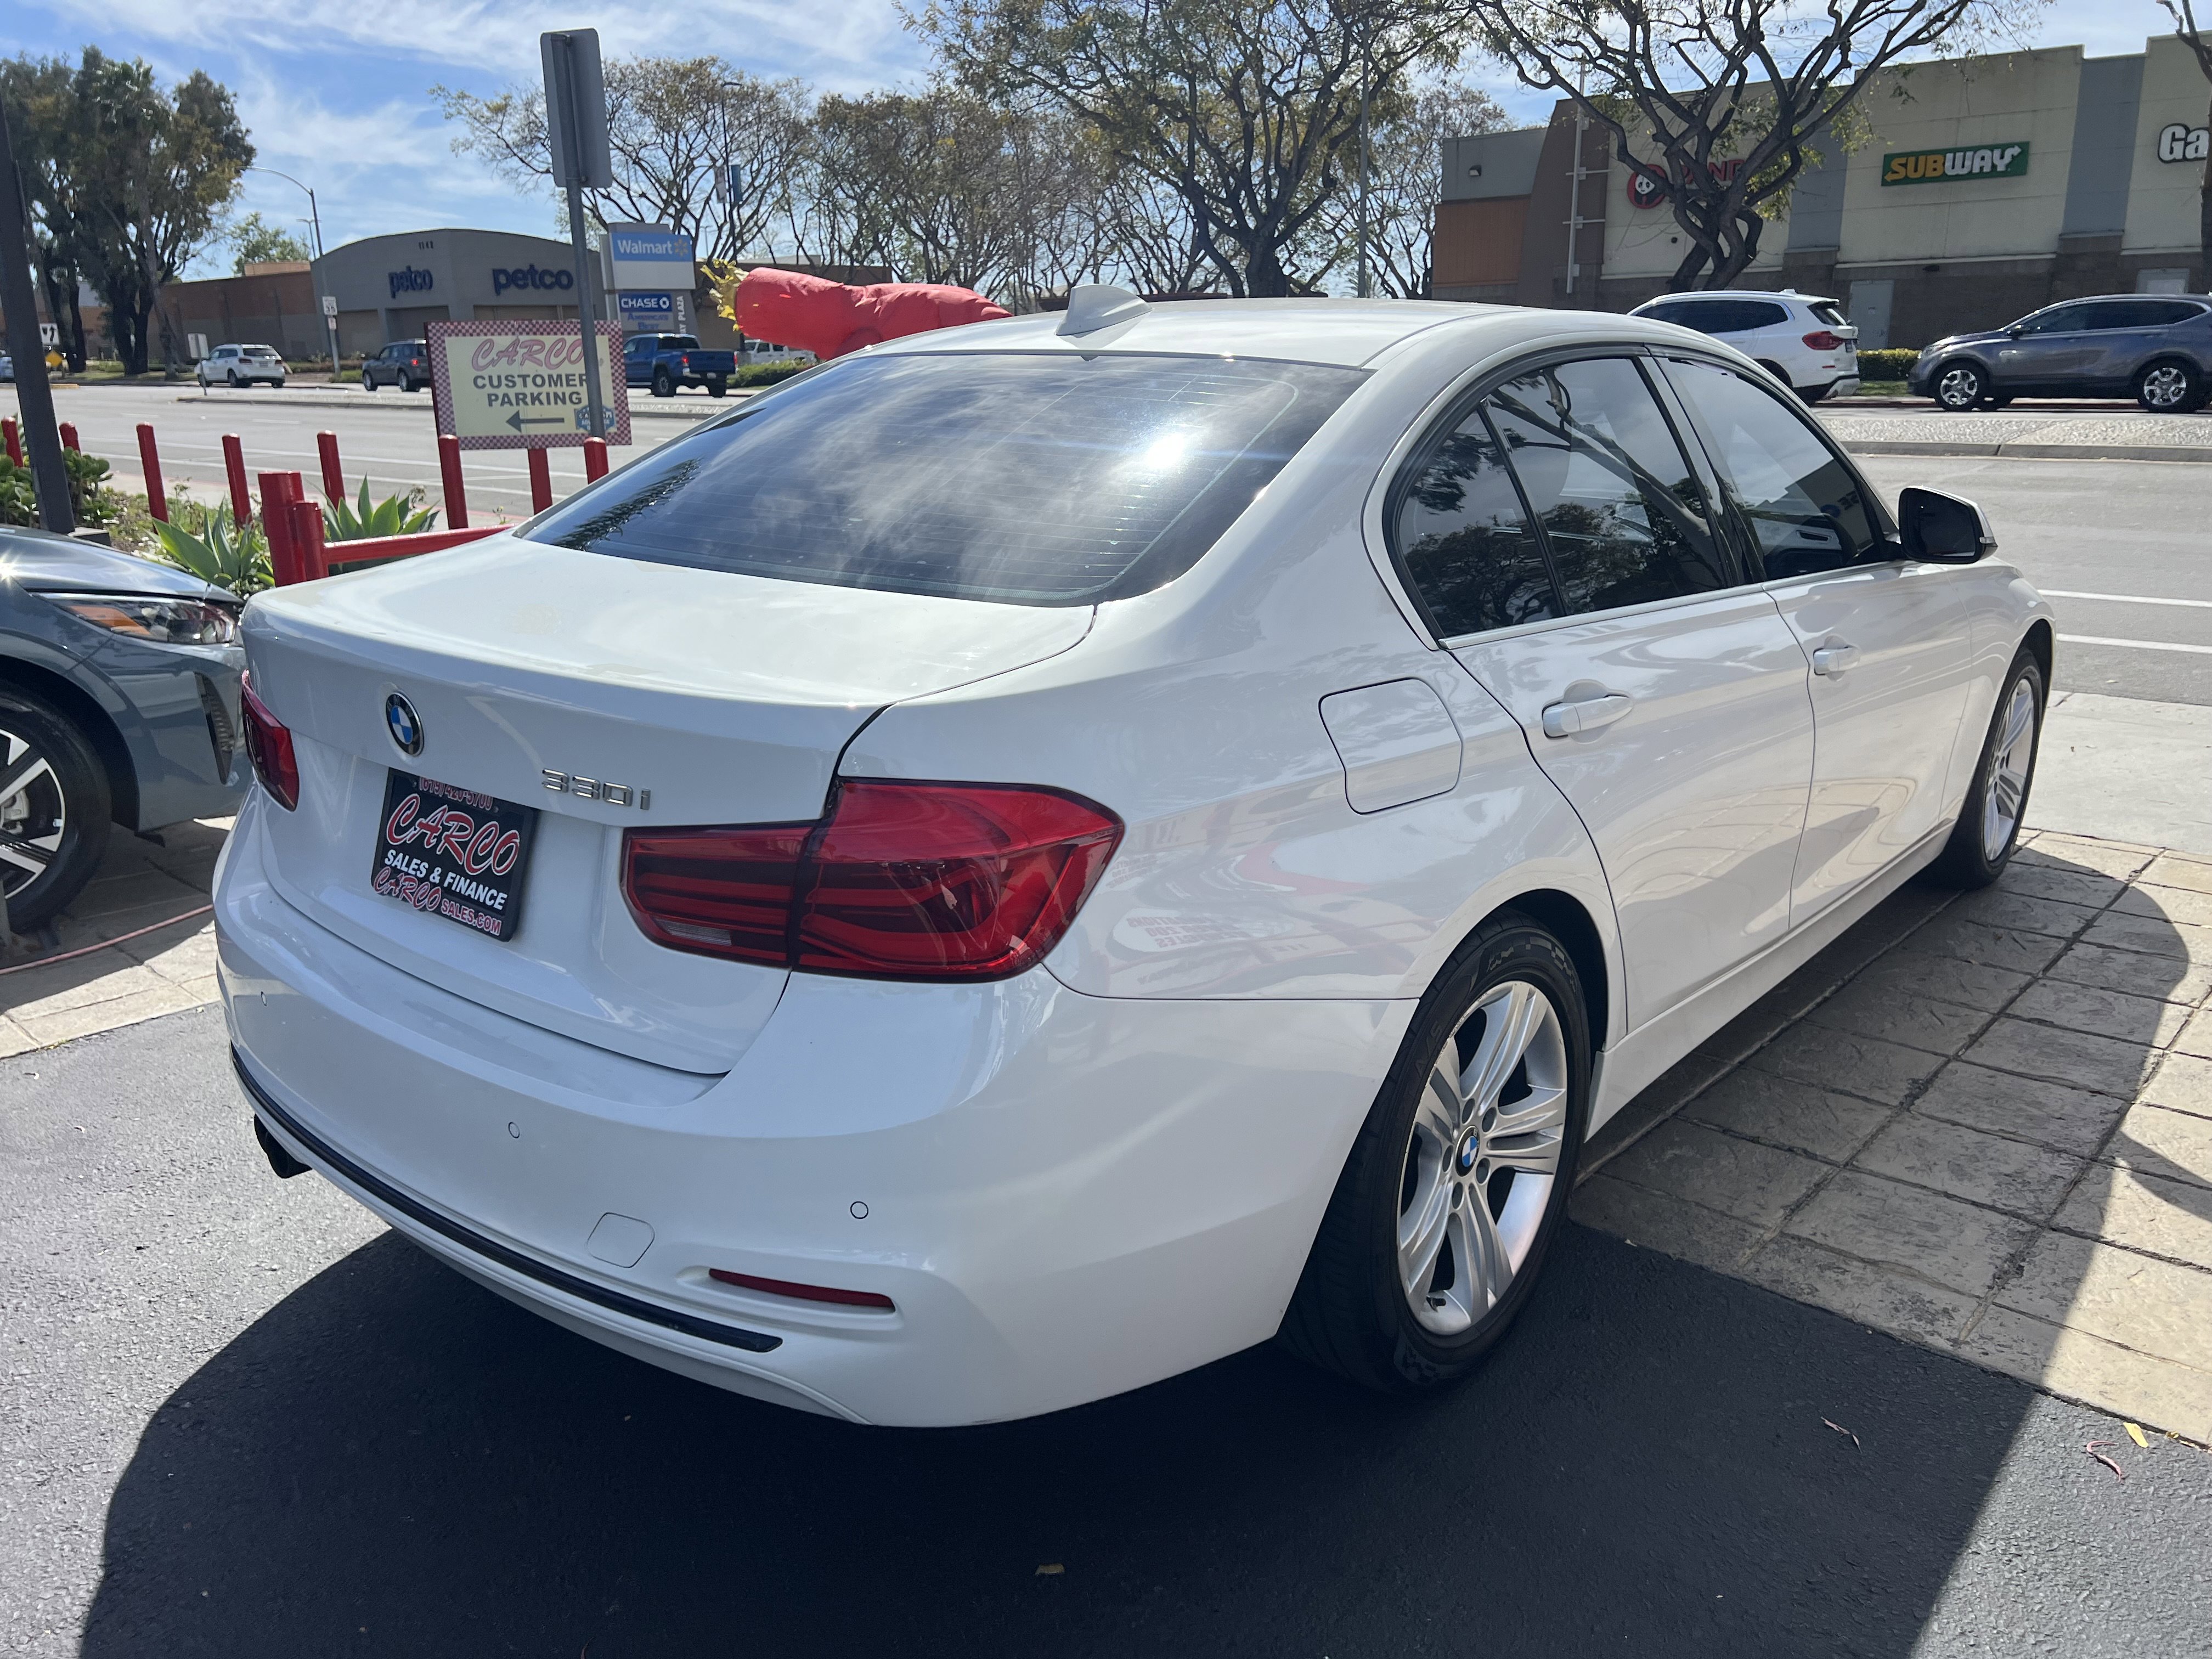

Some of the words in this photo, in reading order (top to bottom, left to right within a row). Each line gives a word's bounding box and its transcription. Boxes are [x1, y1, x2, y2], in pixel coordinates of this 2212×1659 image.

[1884, 145, 2022, 182] SUBWAY
[617, 240, 673, 255] Walmart
[388, 265, 433, 299] petco
[493, 263, 573, 296] petco
[620, 298, 658, 308] CHASE
[472, 337, 585, 371] CARCO
[487, 392, 582, 407] PARKING
[541, 768, 651, 811] 330i
[387, 793, 520, 876] CARCO
[385, 849, 429, 878] SALES
[430, 867, 442, 884] &
[443, 872, 507, 910] FINANCE
[373, 866, 442, 911] CARCO
[441, 898, 501, 936] SALES.COM
